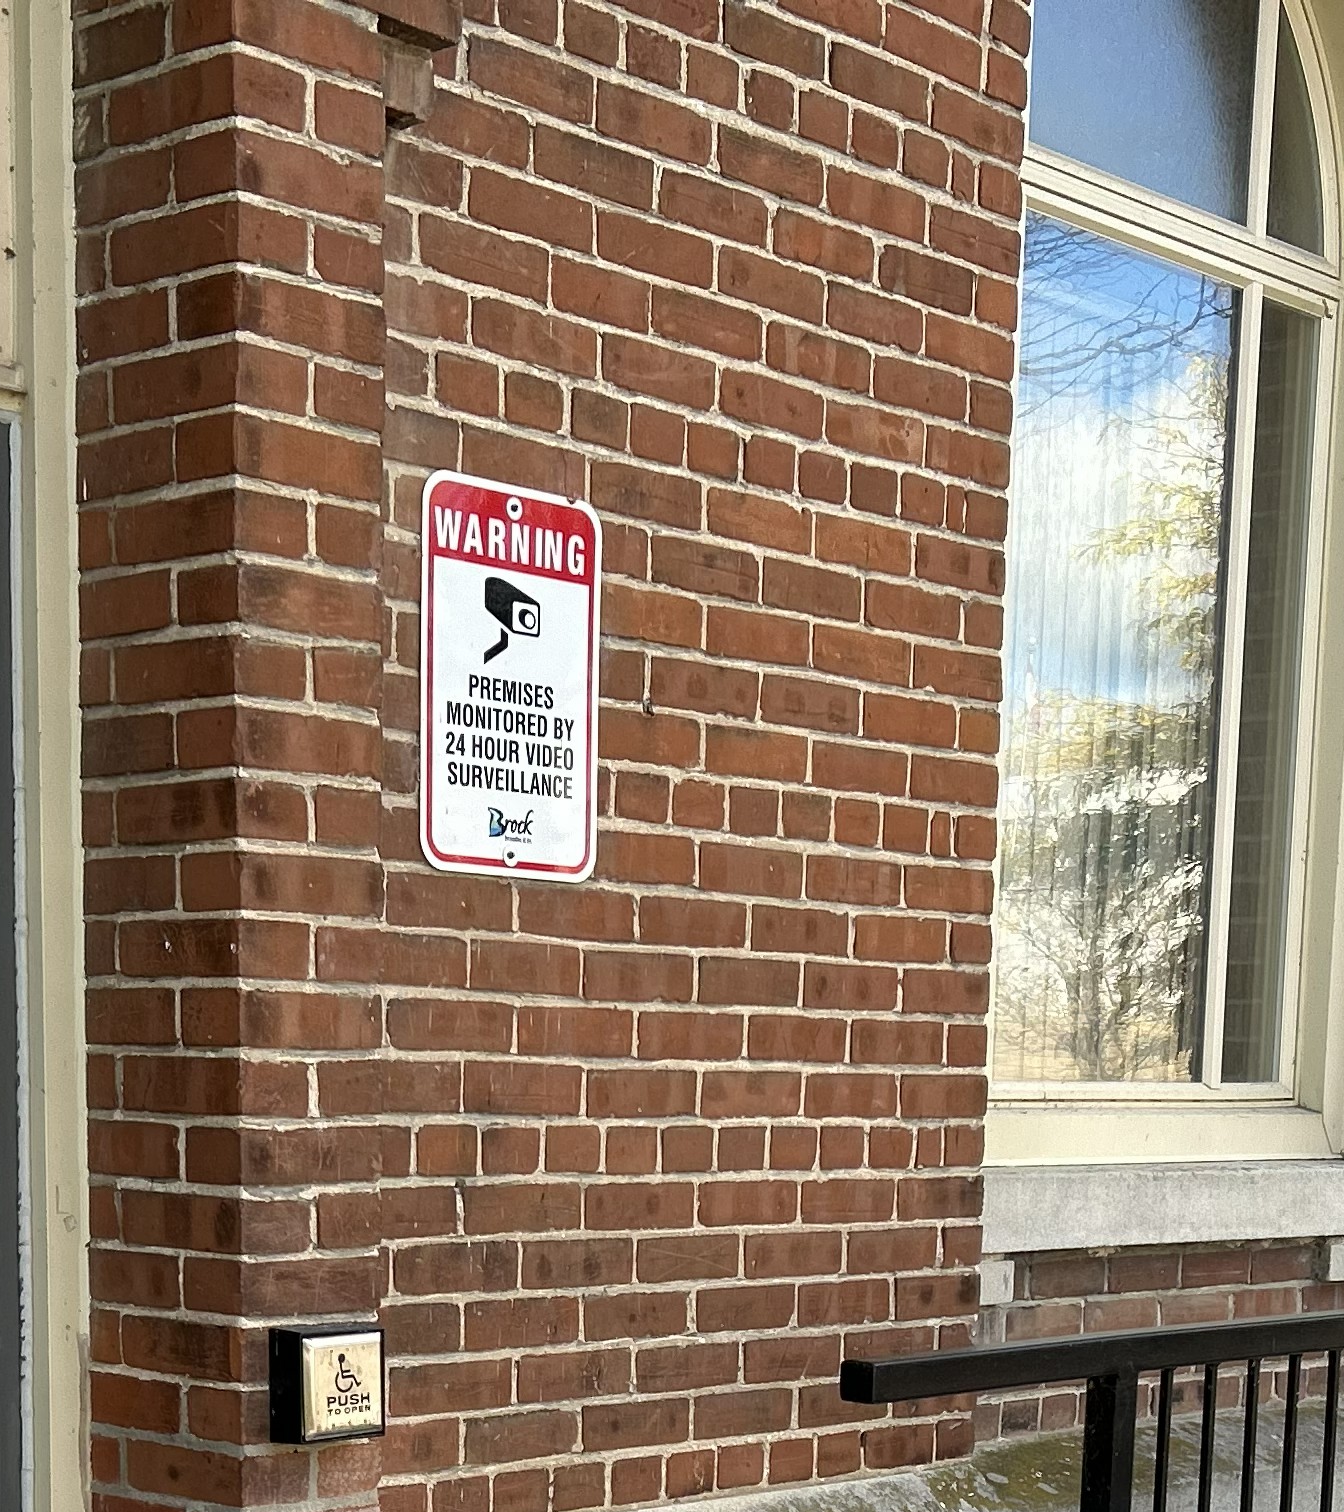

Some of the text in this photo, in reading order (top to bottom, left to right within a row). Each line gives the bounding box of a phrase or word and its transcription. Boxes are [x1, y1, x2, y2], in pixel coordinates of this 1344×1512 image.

[433, 505, 586, 577] WARNING
[468, 674, 554, 710] PREMISES
[446, 701, 575, 742] MONITORED BY
[445, 732, 574, 771] 24 HOUR VIDEO
[447, 762, 573, 800] SURVEILLANCE
[488, 806, 534, 837] Brock
[327, 1392, 370, 1408] PUSH
[344, 1405, 371, 1414] OPEN
